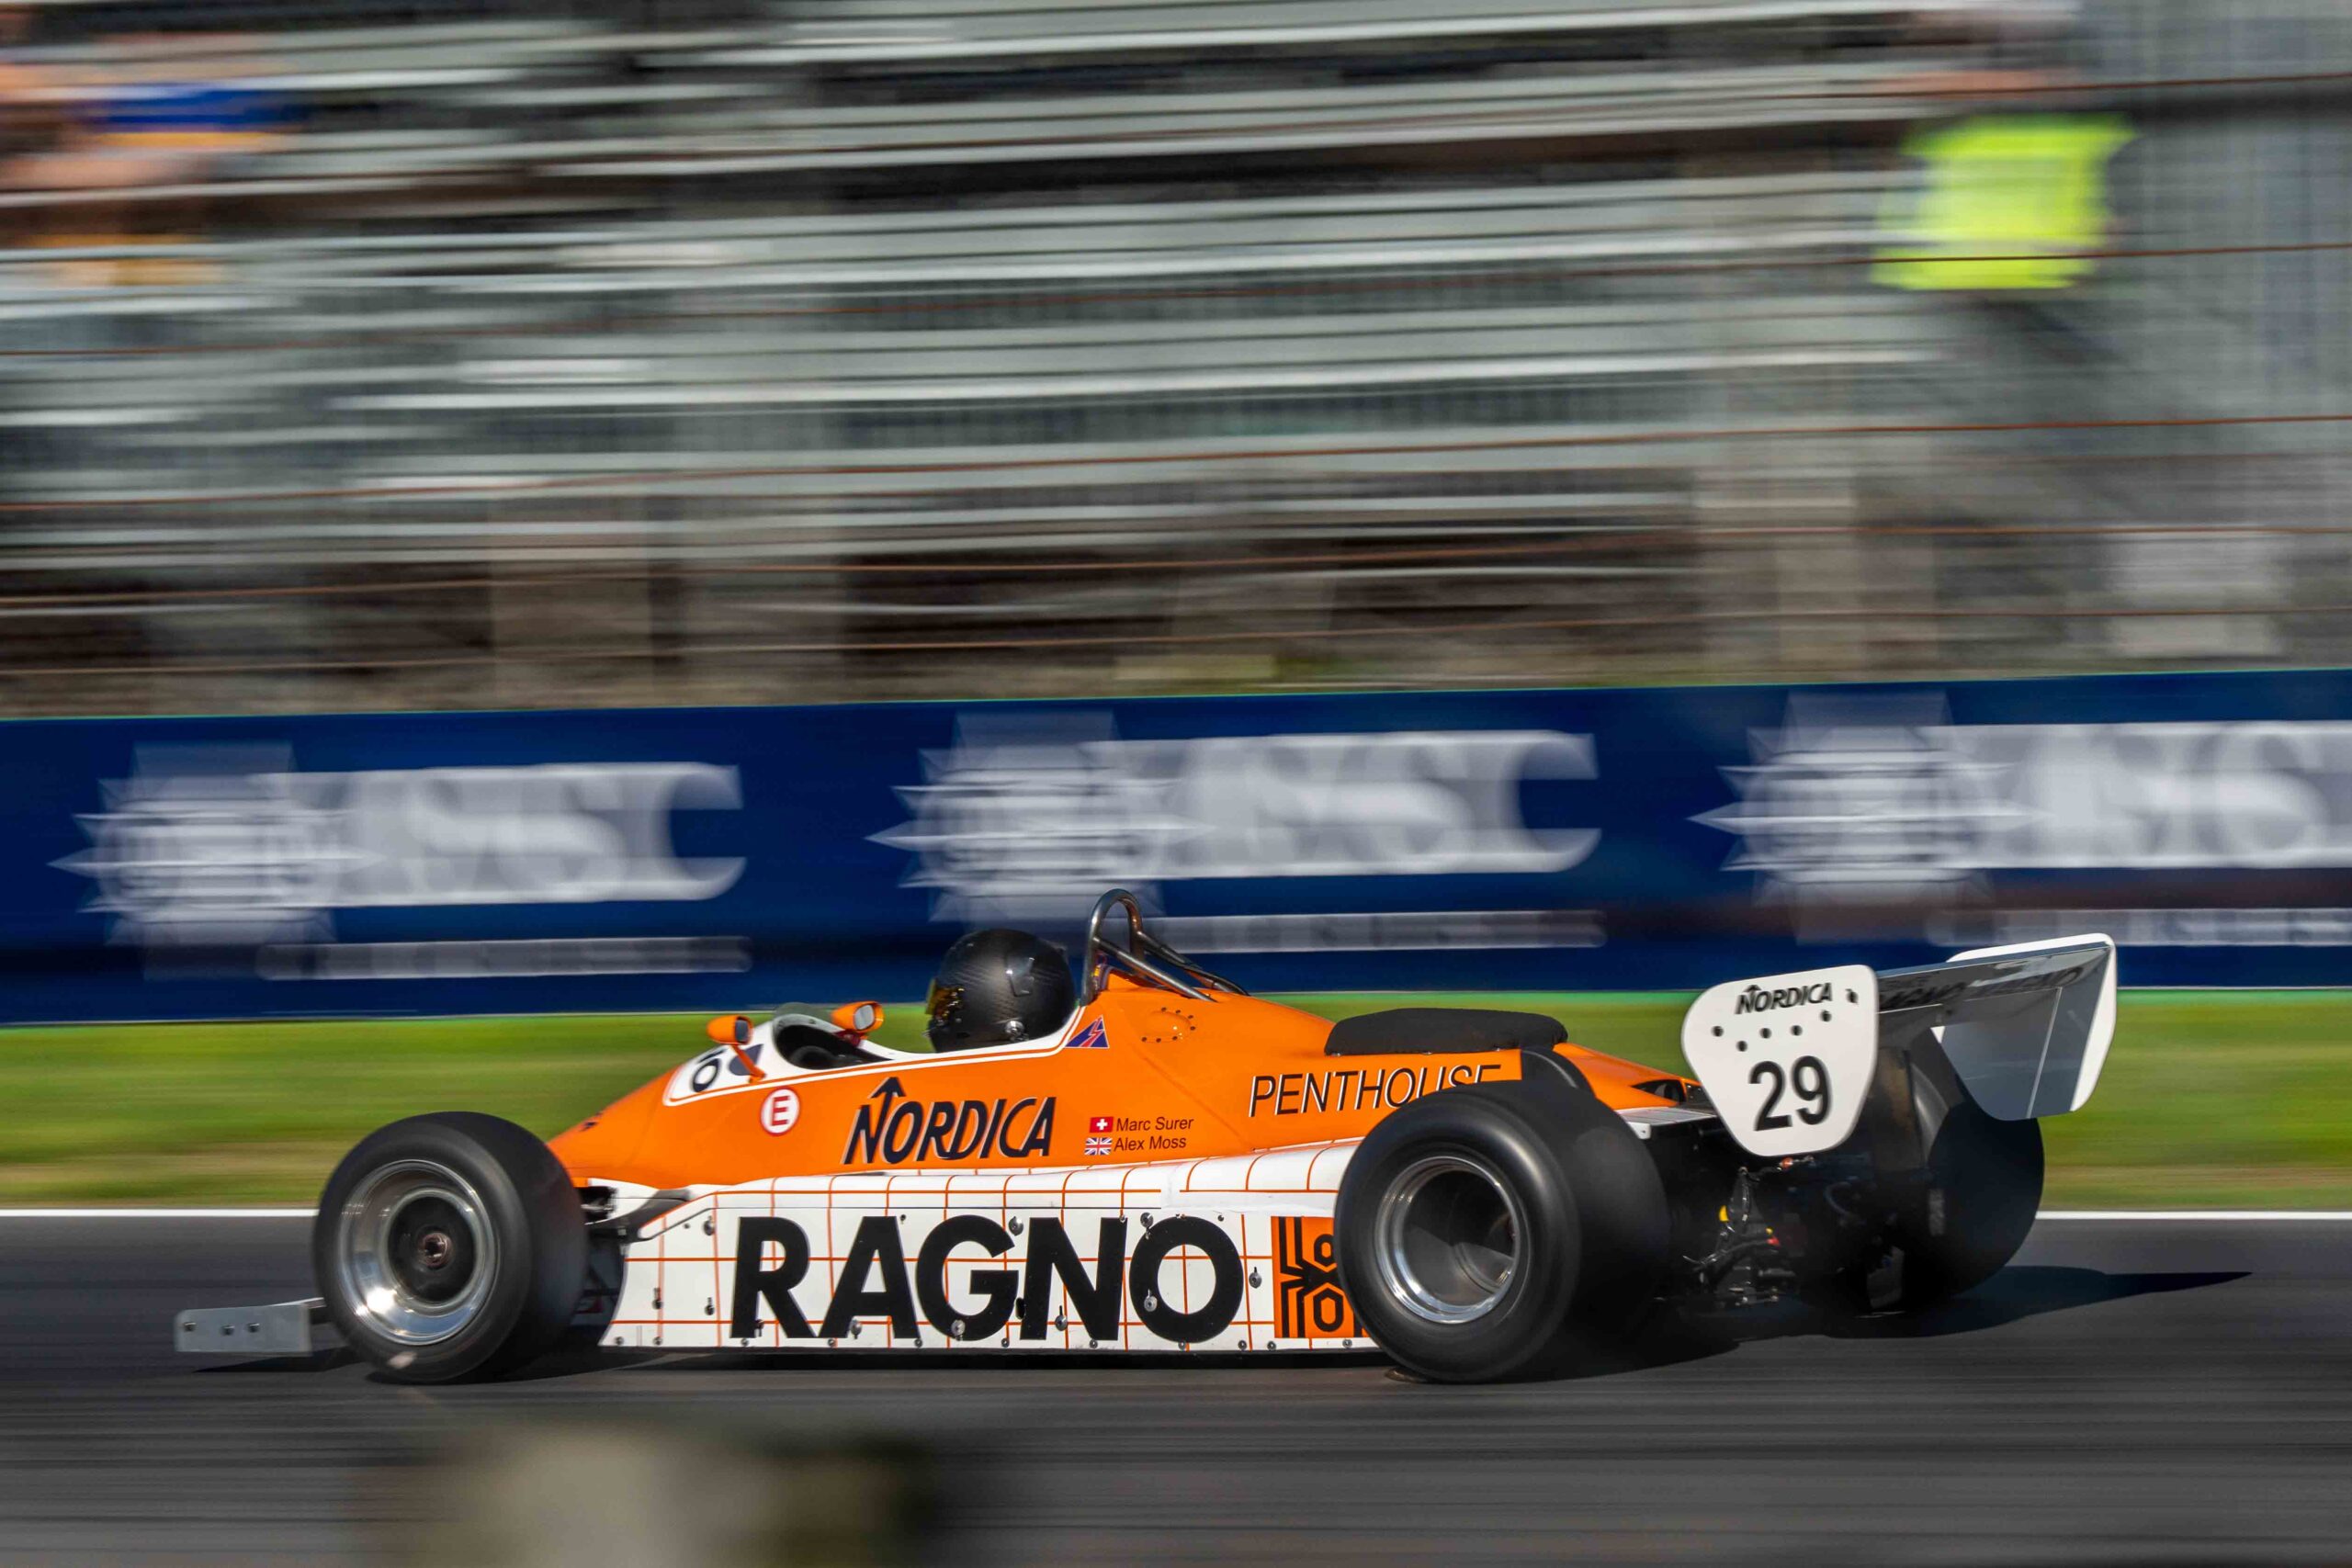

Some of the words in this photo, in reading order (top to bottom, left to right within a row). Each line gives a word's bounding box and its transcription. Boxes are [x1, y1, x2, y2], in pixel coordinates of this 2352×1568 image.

[1735, 983, 1833, 1015] NORDICA
[1748, 1055, 1833, 1132] 29
[843, 1077, 1057, 1165] NORDICA
[1113, 1137, 1145, 1152] Alex
[1148, 1135, 1187, 1150] Moss
[1116, 1118, 1151, 1133] Marc
[1155, 1116, 1194, 1131] Surer
[729, 1214, 1244, 1344] RAGNO
